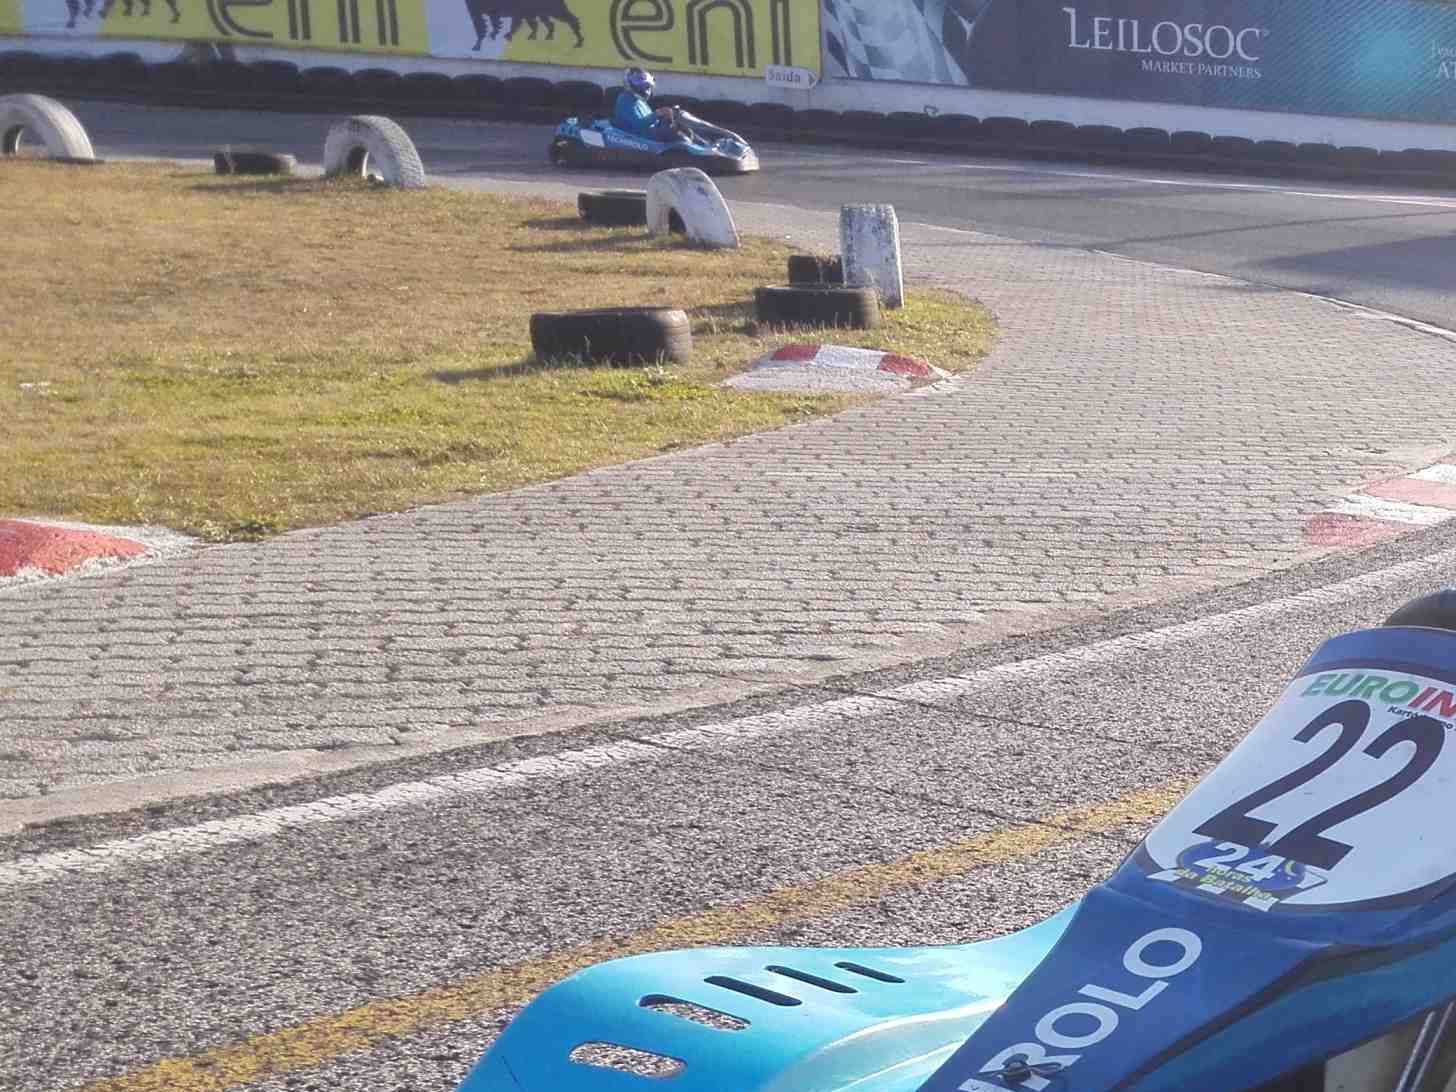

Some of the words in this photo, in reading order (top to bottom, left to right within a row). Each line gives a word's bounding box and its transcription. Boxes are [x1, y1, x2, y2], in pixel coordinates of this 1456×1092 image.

[1141, 59, 1195, 75] MARKET
[1198, 63, 1262, 80] PARTNERS
[1192, 698, 1446, 872] 22
[1193, 841, 1287, 882] 24
[1200, 873, 1278, 902] Batalha
